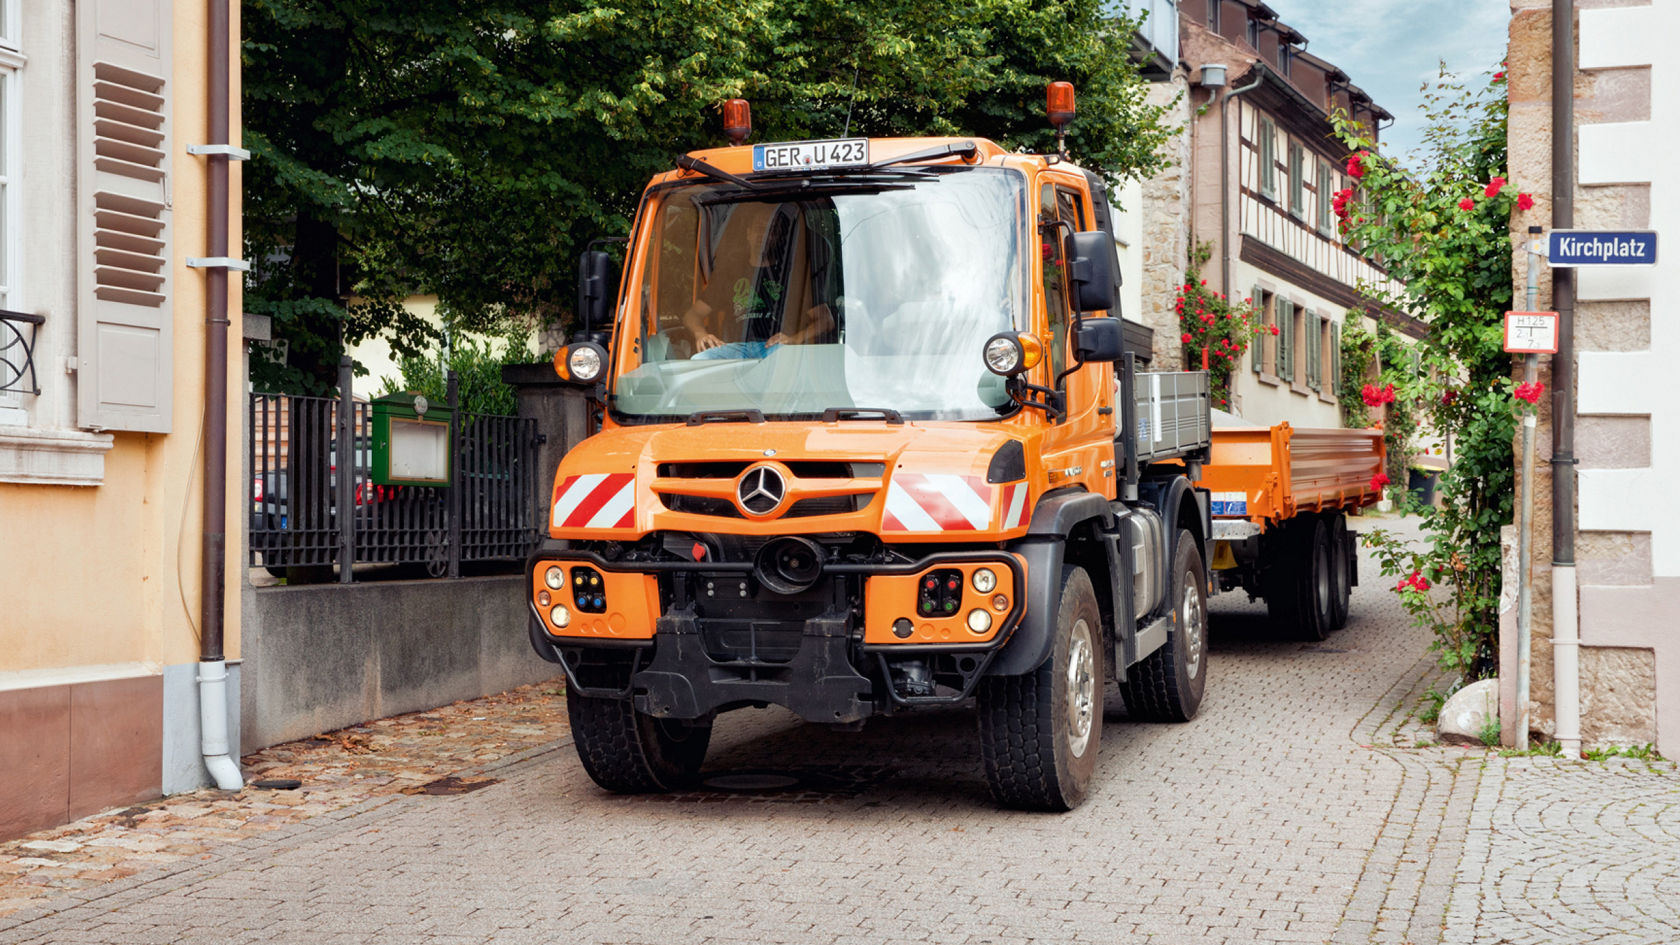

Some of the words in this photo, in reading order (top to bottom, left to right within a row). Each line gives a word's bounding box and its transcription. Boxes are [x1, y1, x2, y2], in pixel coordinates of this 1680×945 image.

[765, 147, 801, 167] GER
[814, 145, 826, 164] U
[830, 142, 865, 163] 423
[1559, 237, 1646, 262] Kirchplatz
